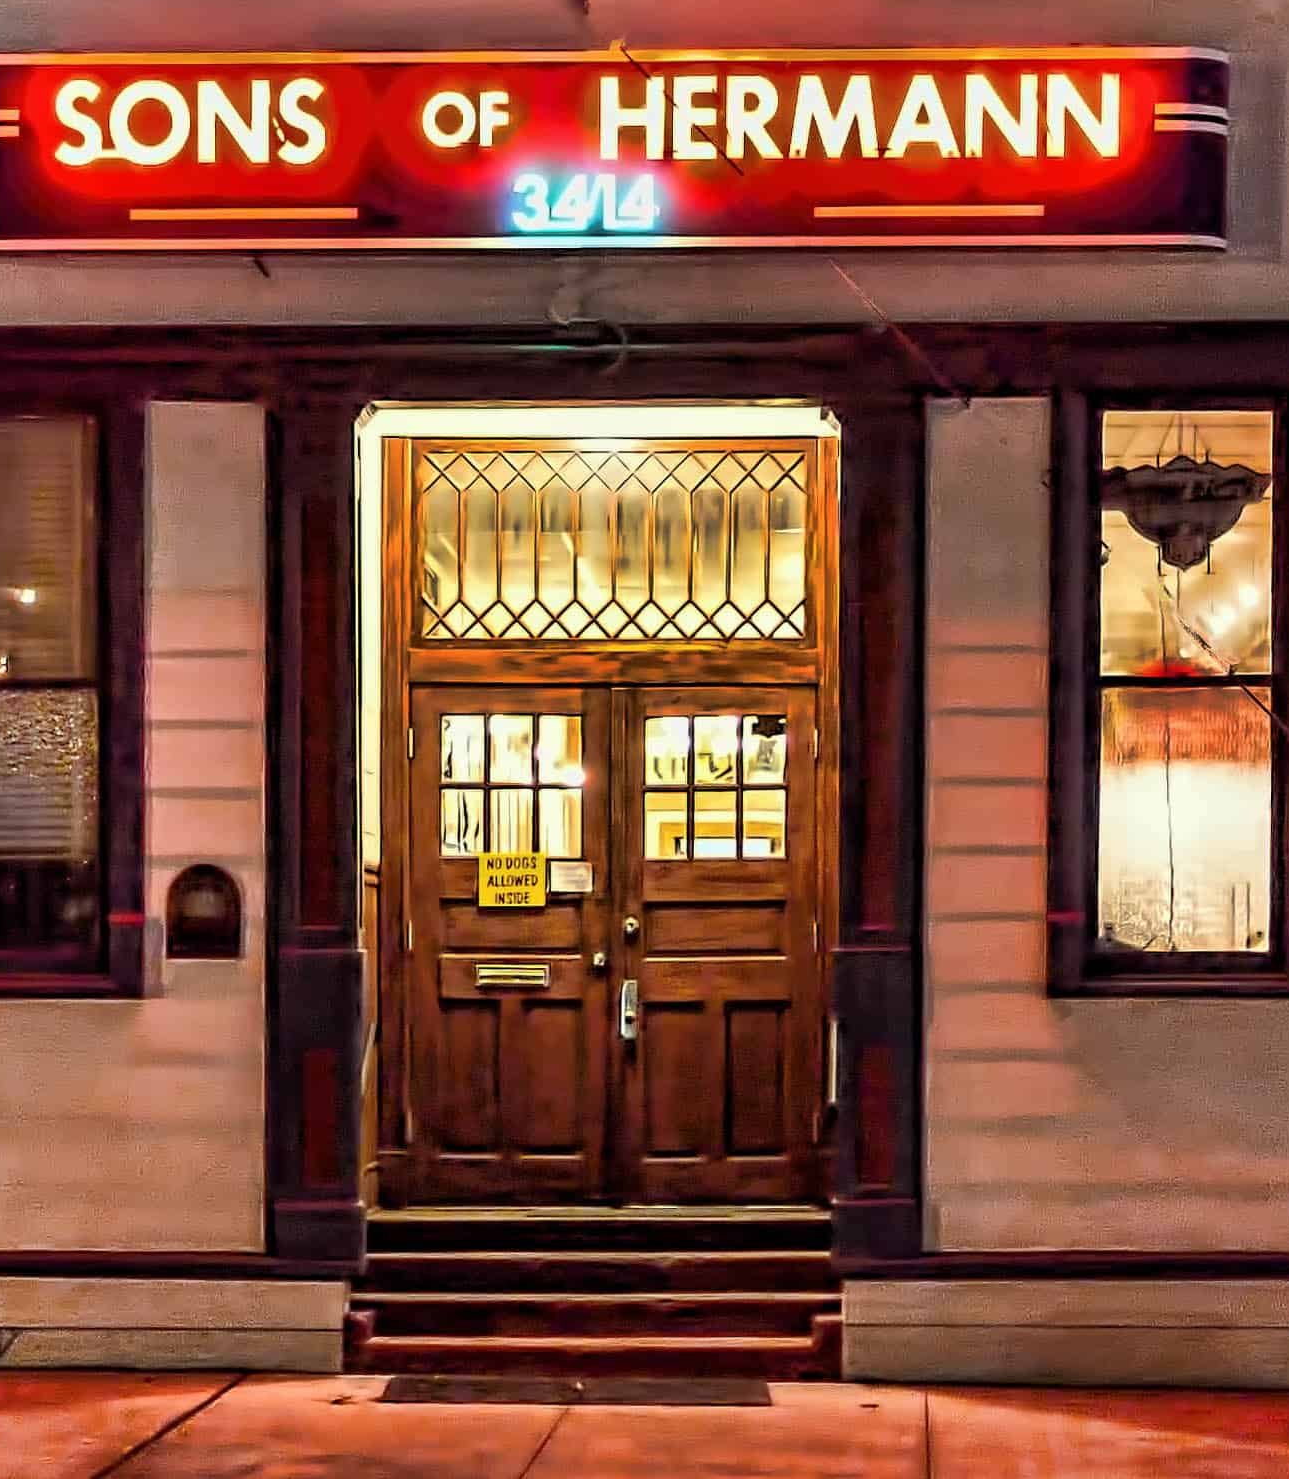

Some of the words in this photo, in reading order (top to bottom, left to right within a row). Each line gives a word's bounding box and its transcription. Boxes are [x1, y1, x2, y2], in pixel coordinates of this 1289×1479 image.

[54, 77, 327, 167] SONS
[421, 90, 510, 149] OF
[599, 73, 1120, 161] HERMANN
[511, 173, 660, 231] 3414
[486, 857, 502, 870] NO
[505, 856, 537, 870] DOGS
[486, 873, 539, 888] ALLOWED
[494, 892, 531, 905] INSIDE
